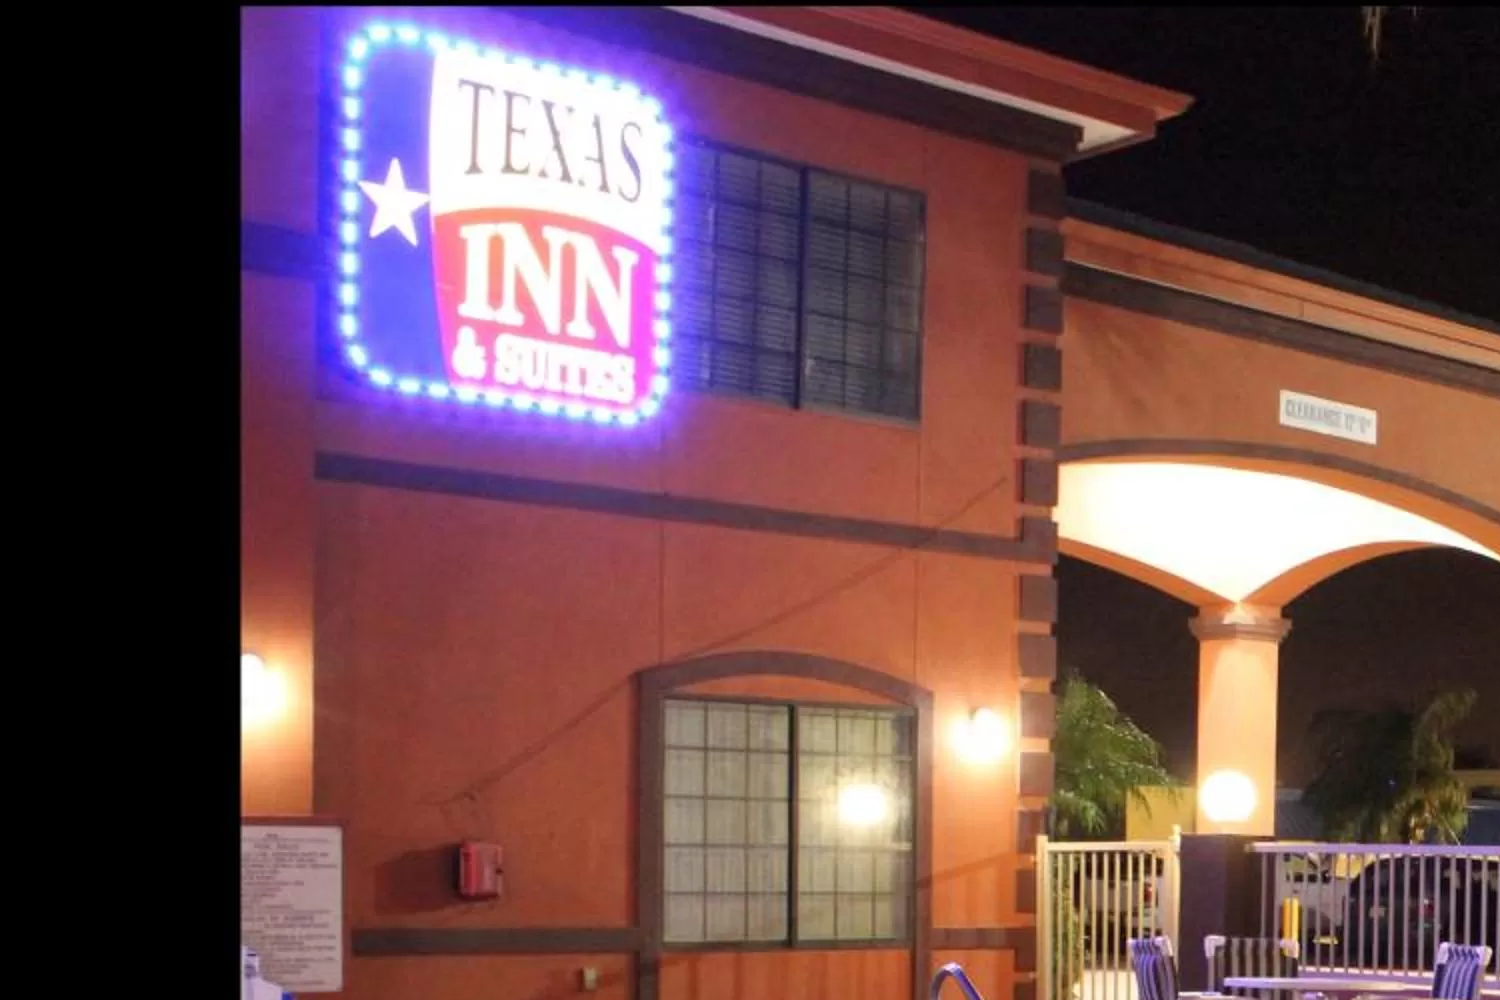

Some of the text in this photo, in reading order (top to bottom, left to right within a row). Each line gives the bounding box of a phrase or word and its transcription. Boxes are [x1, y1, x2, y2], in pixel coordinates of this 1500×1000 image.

[458, 78, 642, 203] TEXAS
[458, 221, 640, 350] INN
[494, 333, 636, 404] SUITES
